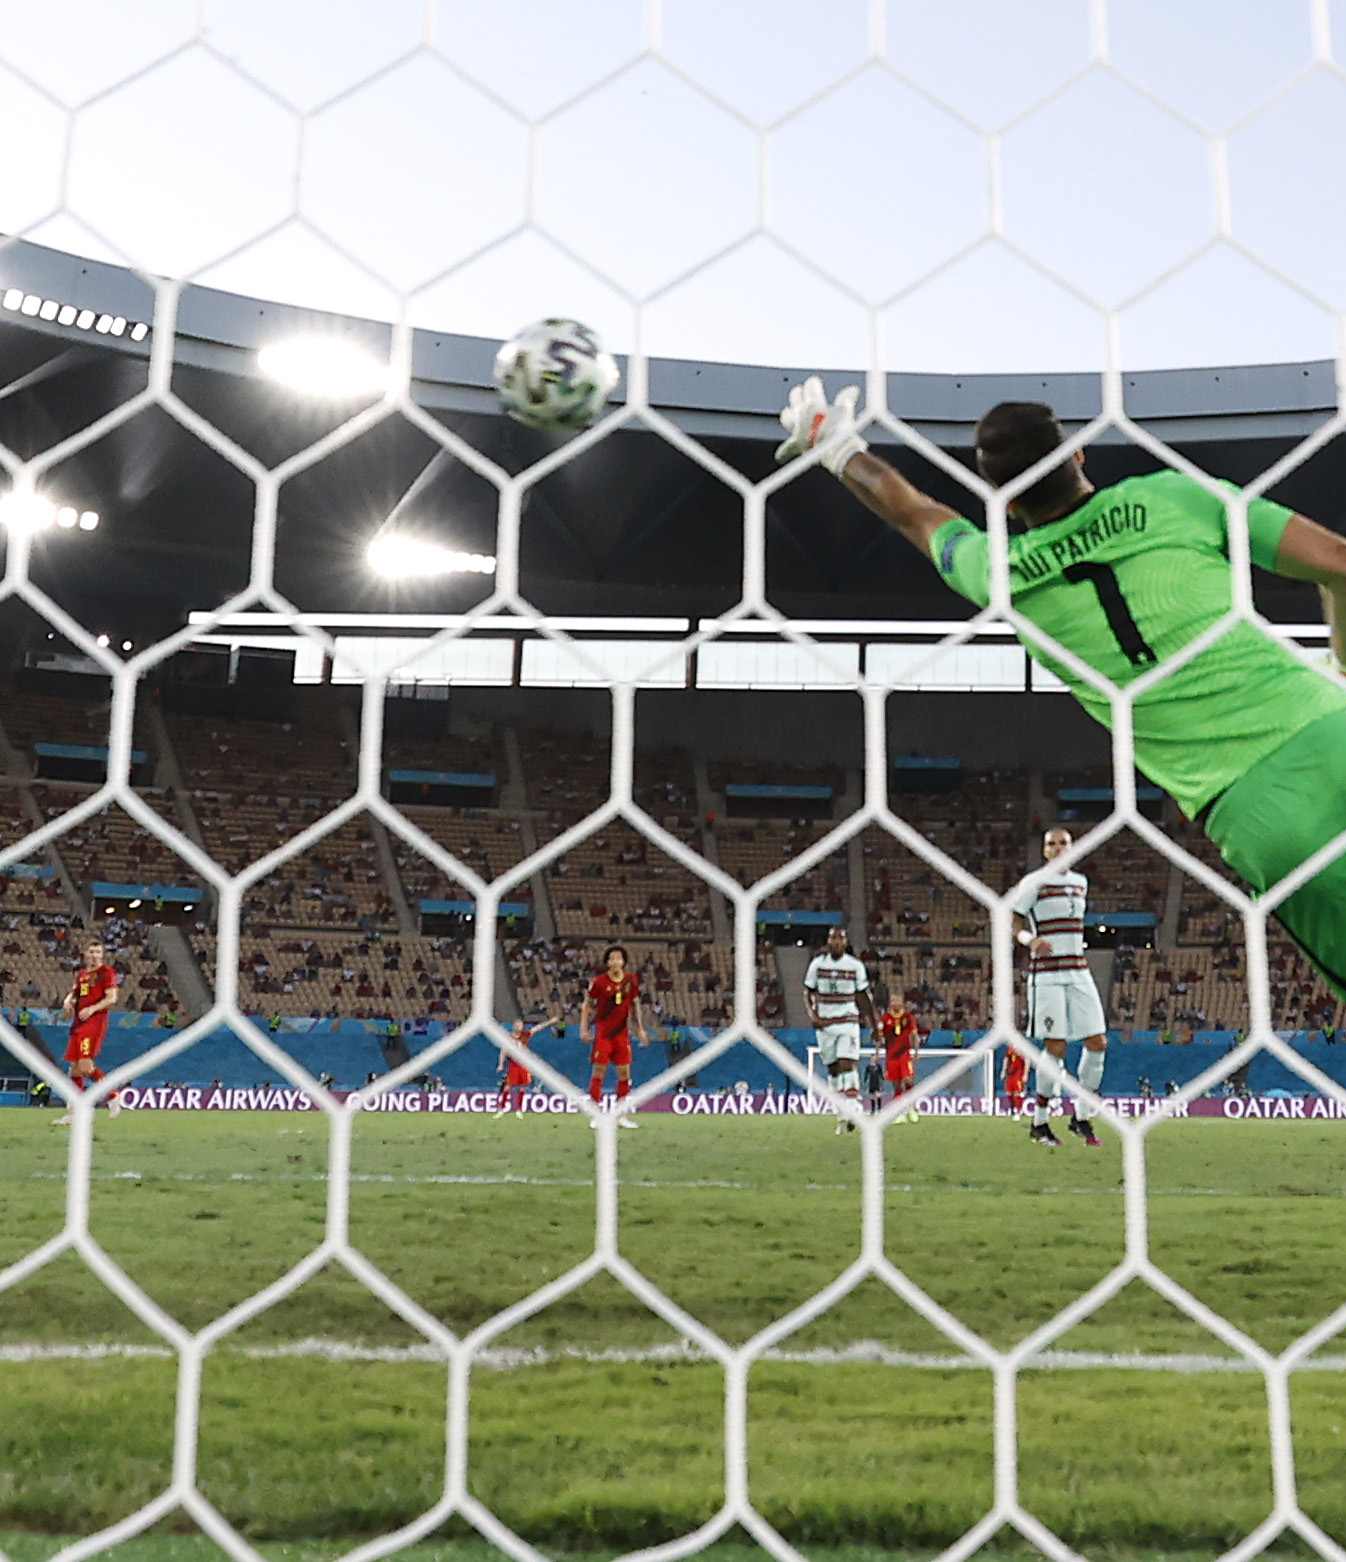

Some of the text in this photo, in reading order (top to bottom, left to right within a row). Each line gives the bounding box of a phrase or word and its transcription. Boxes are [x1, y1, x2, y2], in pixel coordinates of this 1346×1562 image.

[1010, 503, 1147, 582] UI PATRICIO
[1061, 561, 1158, 666] 1
[119, 1087, 312, 1111] QATAR AIRWAYS
[672, 1094, 864, 1115] QATAR AIRWA
[914, 1098, 973, 1116] OING
[1069, 1097, 1189, 1118] TGETHER
[1223, 1098, 1305, 1119] QATAR
